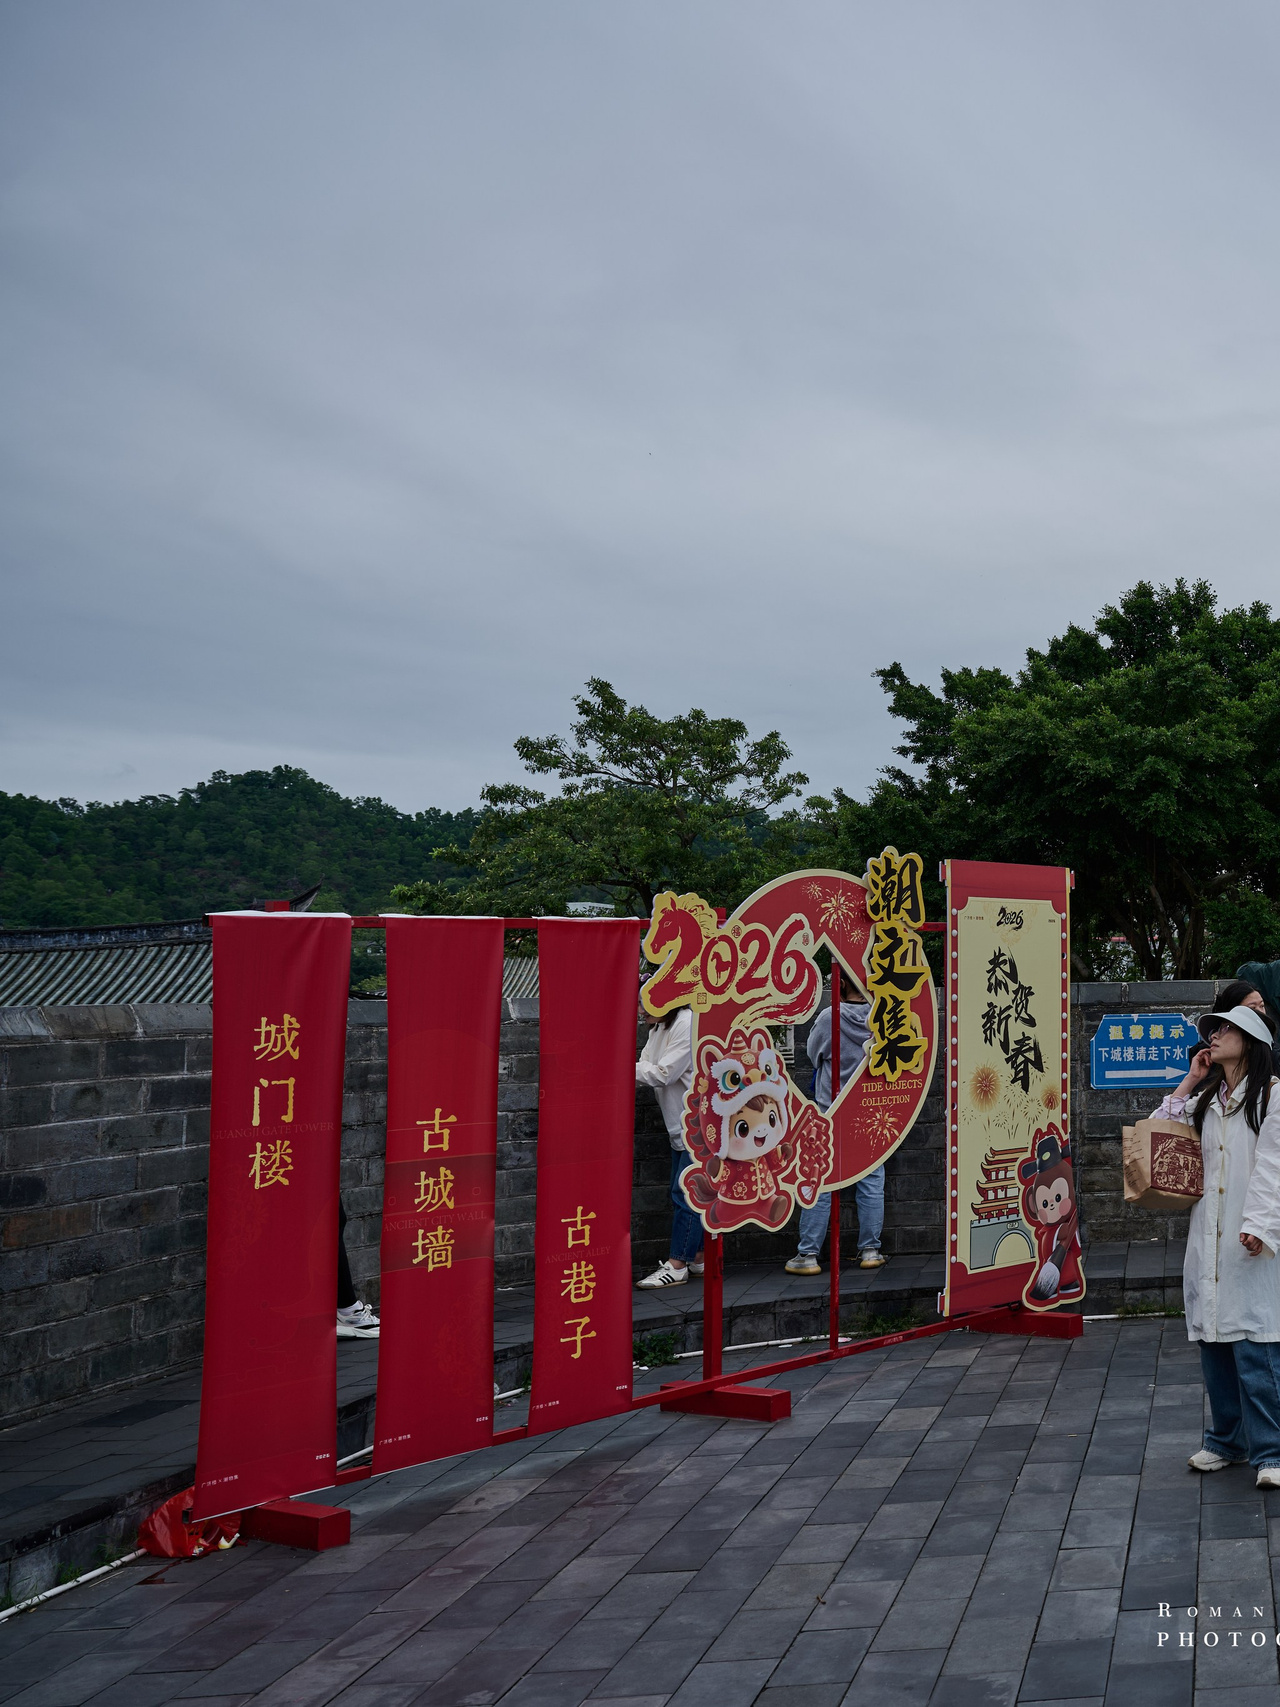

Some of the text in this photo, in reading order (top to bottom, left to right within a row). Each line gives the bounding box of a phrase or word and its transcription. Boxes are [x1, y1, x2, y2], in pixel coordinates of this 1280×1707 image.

[996, 906, 1024, 931] 2026
[648, 897, 818, 1024] 2026
[981, 946, 1044, 1094] 恭贺新春
[1109, 1024, 1185, 1040] 温馨提示
[862, 1079, 923, 1092] TIDE OBJECTS
[248, 1013, 300, 1190] 城门楼
[861, 1095, 910, 1106] COLLECTION
[262, 1125, 291, 1137] GATE
[293, 1122, 335, 1132] TOWER
[411, 1107, 458, 1273] 古城墙
[383, 1210, 487, 1233] ANCIENT CITY WALL
[545, 1246, 612, 1264] ANCIENT ALLEY
[560, 1205, 597, 1359] 古巷子
